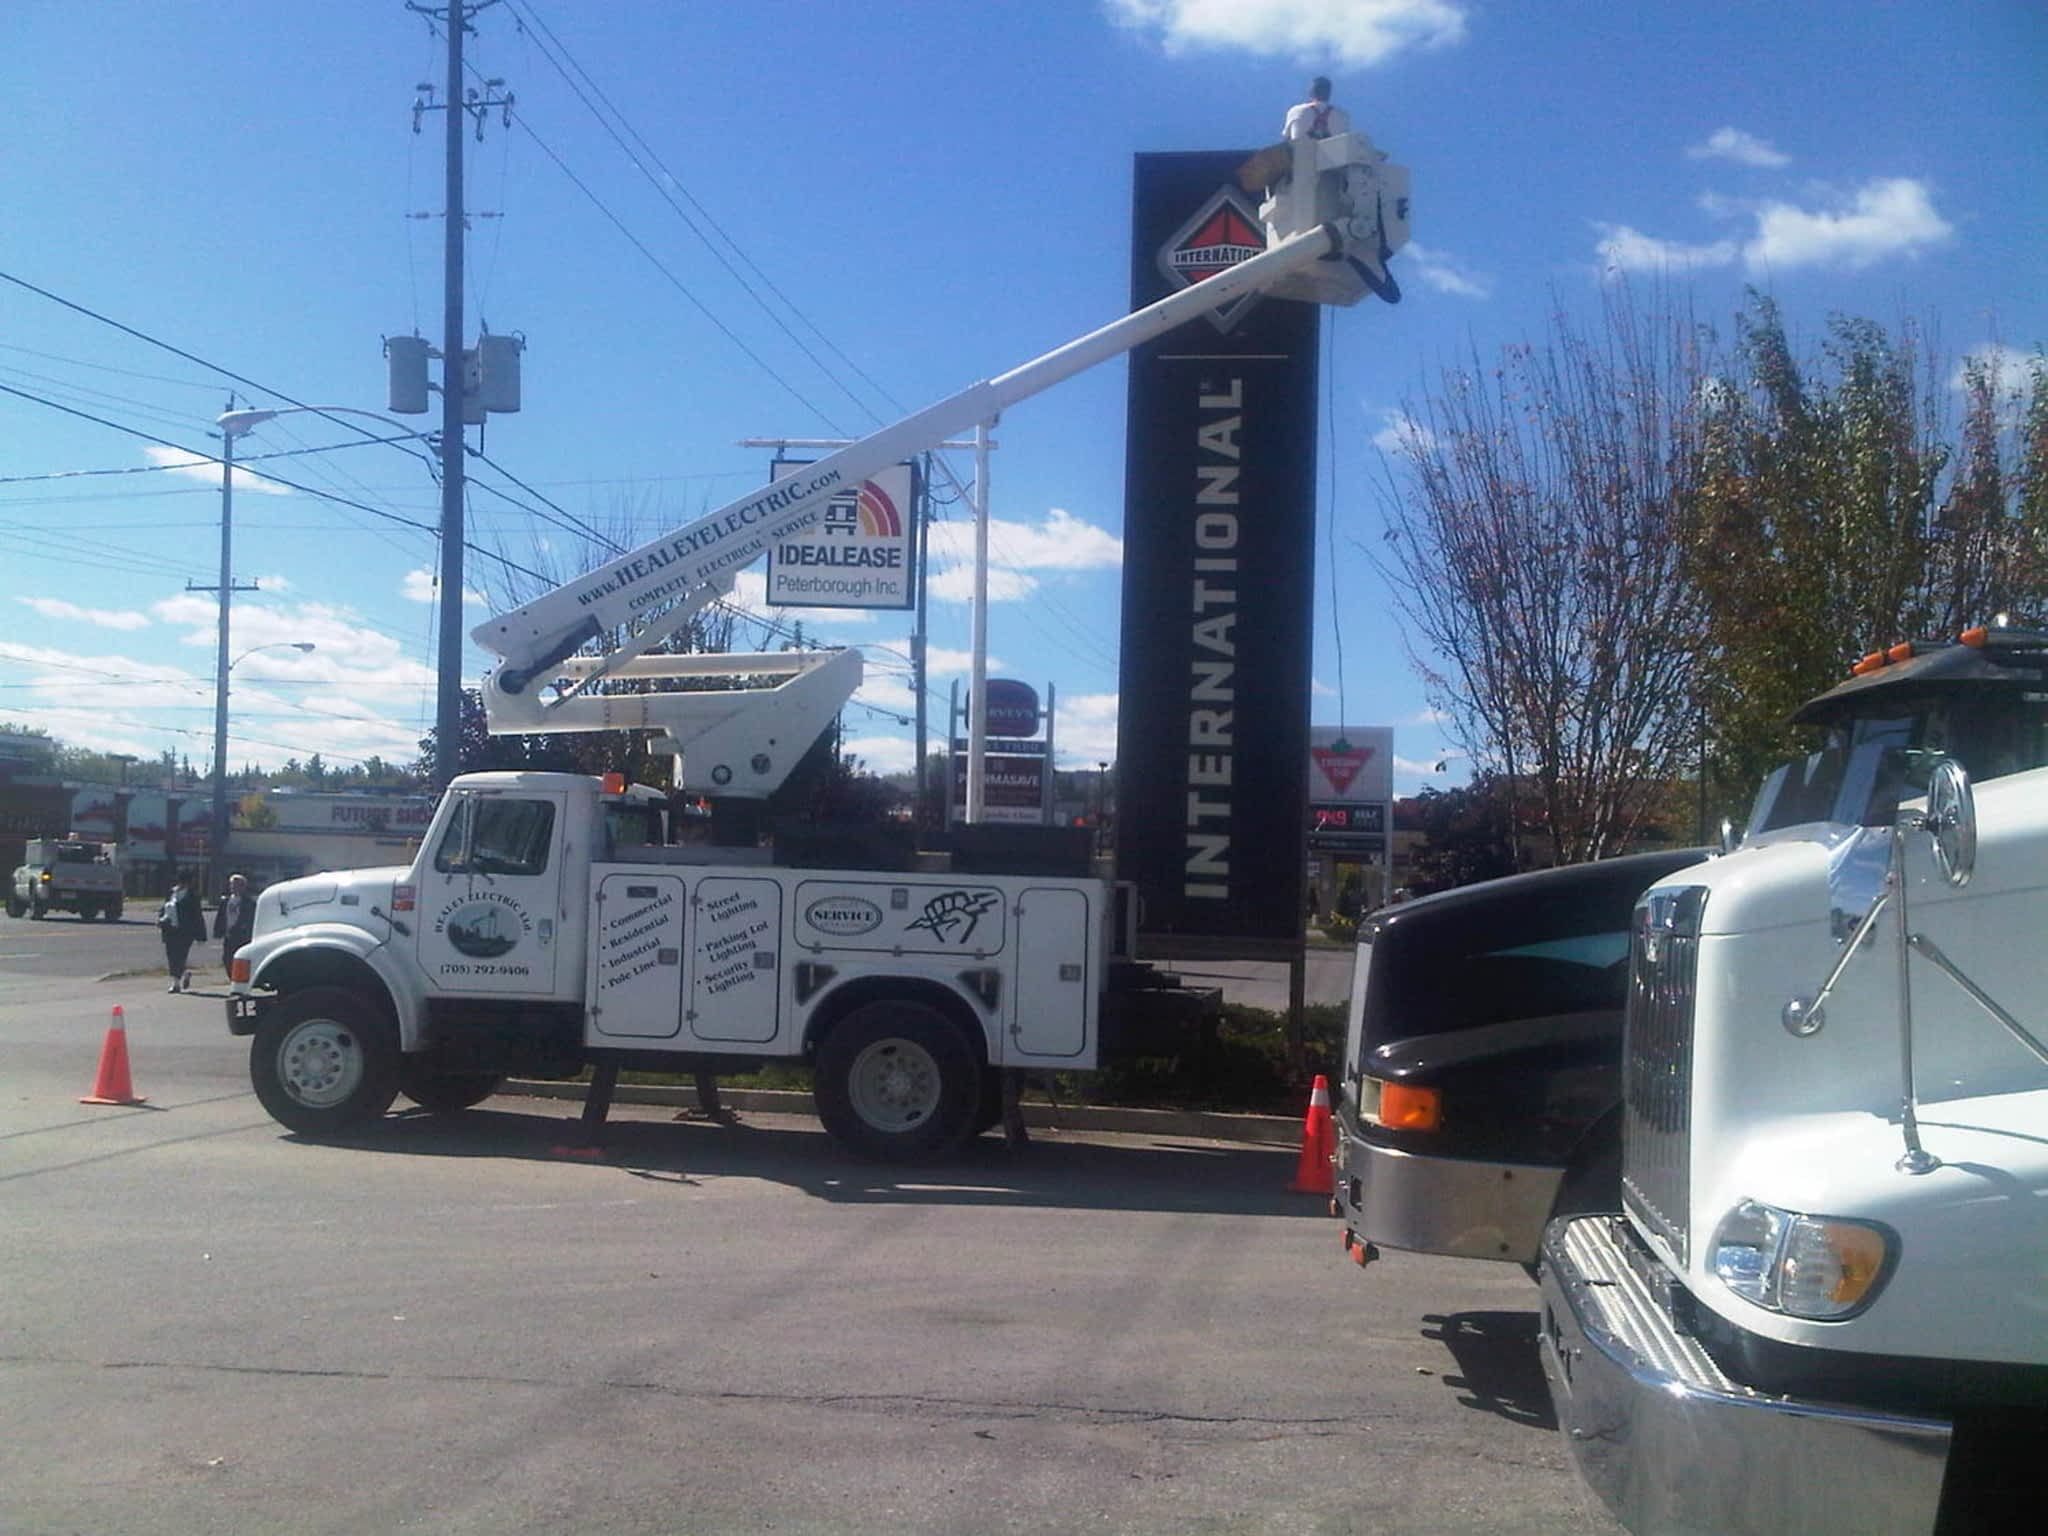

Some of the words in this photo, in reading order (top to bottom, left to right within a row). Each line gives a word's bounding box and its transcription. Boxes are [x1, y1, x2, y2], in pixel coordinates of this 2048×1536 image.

[628, 574, 688, 610] COMPLETE
[696, 538, 763, 579] ELECTRICAL
[771, 511, 819, 541] SERVICE
[778, 543, 901, 569] IDEALEASE
[776, 574, 872, 598] Peterborough
[875, 577, 900, 595] Inc.
[1185, 378, 1243, 898] INTERNATIONAL
[434, 896, 465, 933] HEALEY
[468, 891, 521, 912] ELECTRIC
[610, 893, 673, 929] Commercial
[707, 891, 740, 910] Street
[711, 899, 758, 922] Lighting
[814, 910, 874, 921] SERVICE
[609, 914, 669, 948] Residential
[706, 930, 748, 952] Parking
[750, 920, 769, 935] Lot
[609, 937, 661, 968] Industrial
[710, 940, 757, 963] Lighting
[440, 964, 470, 976] (705)
[608, 972, 632, 988] Pole
[633, 960, 657, 976] Line
[704, 961, 749, 982] Security
[708, 971, 755, 995] Lighting
